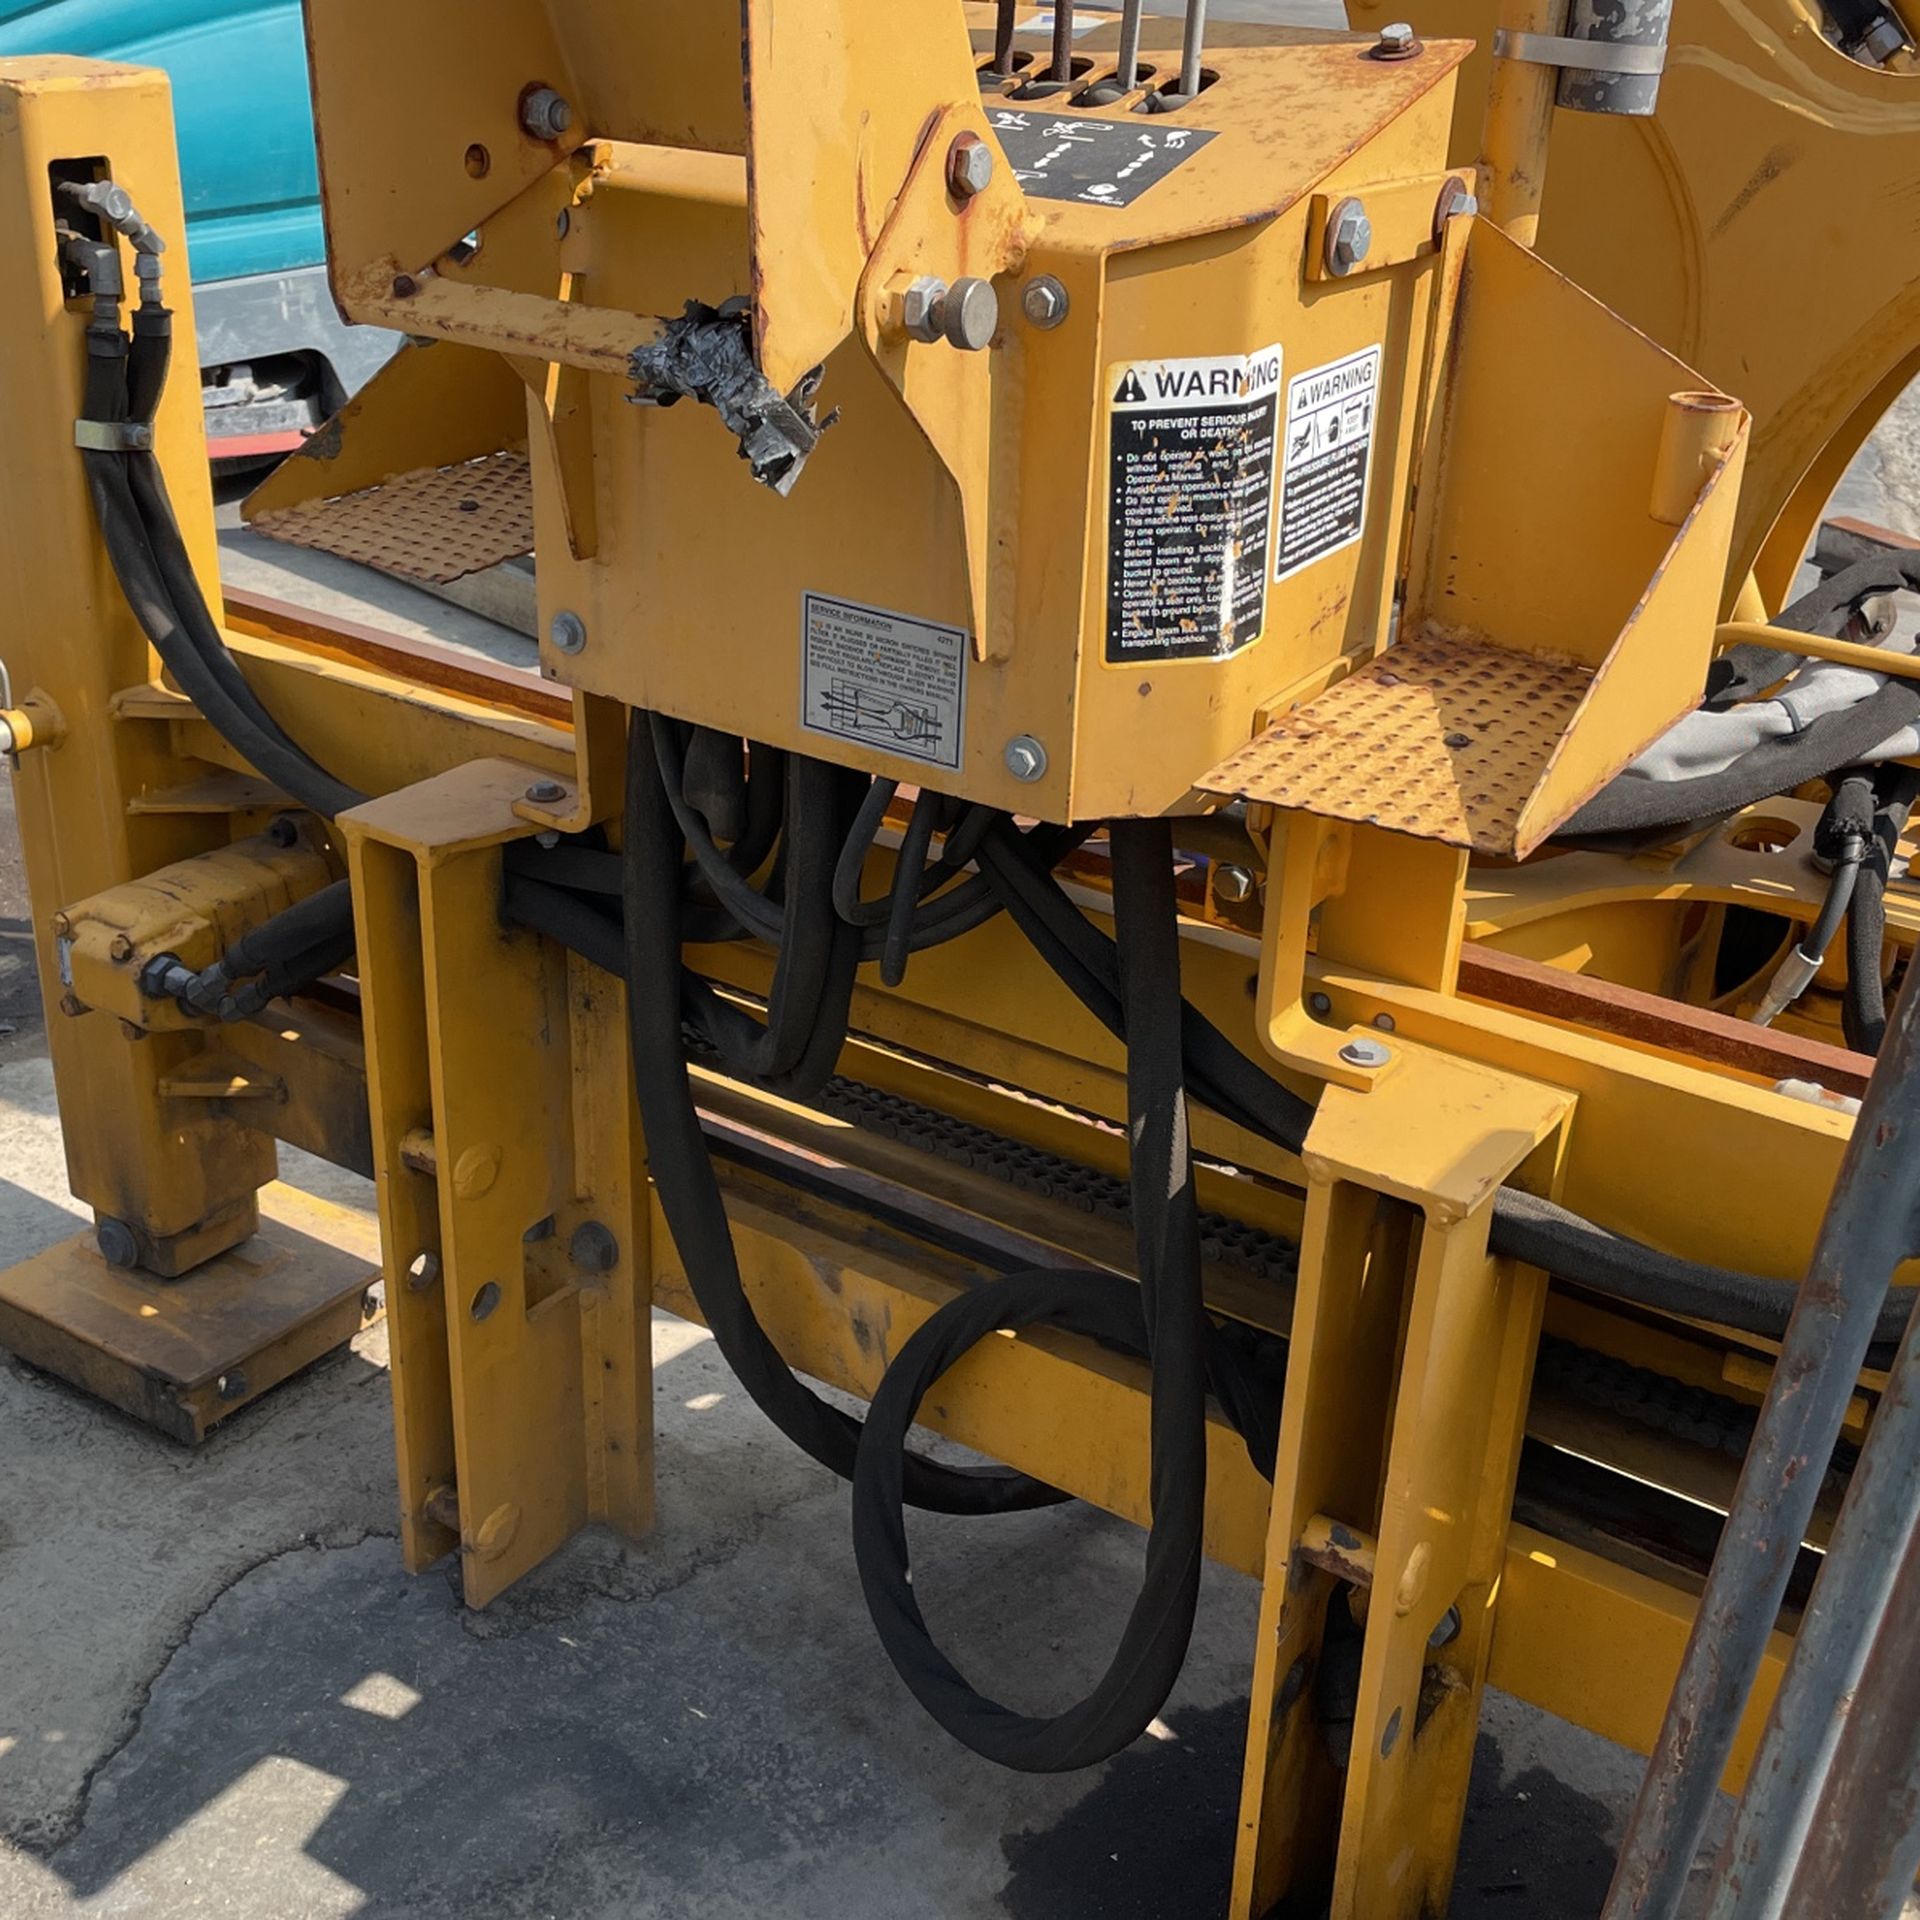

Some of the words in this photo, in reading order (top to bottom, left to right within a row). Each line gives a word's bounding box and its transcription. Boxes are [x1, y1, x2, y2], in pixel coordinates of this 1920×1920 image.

[1155, 357, 1279, 398] WARNING
[1310, 361, 1372, 404] WARNING
[1131, 420, 1146, 430] TO
[1148, 416, 1198, 429] PREVENT
[1201, 414, 1246, 426] SERIOUS
[1180, 428, 1197, 439] OR
[1126, 453, 1138, 462] Do
[1142, 452, 1156, 461] not
[1126, 463, 1156, 473] without
[1212, 459, 1229, 467] and
[1125, 496, 1137, 505] Do
[1140, 495, 1154, 504] not
[1193, 490, 1227, 500] machine
[1125, 517, 1142, 526] This
[1124, 528, 1134, 538] by
[1137, 537, 1154, 545] unit.
[1124, 547, 1151, 557] Before
[1184, 554, 1199, 563] and
[1163, 565, 1193, 576] ground.
[1123, 578, 1148, 588] Never
[1167, 574, 1201, 584] backhoe
[810, 603, 840, 617] SERVICE
[843, 611, 892, 631] INFORMATION
